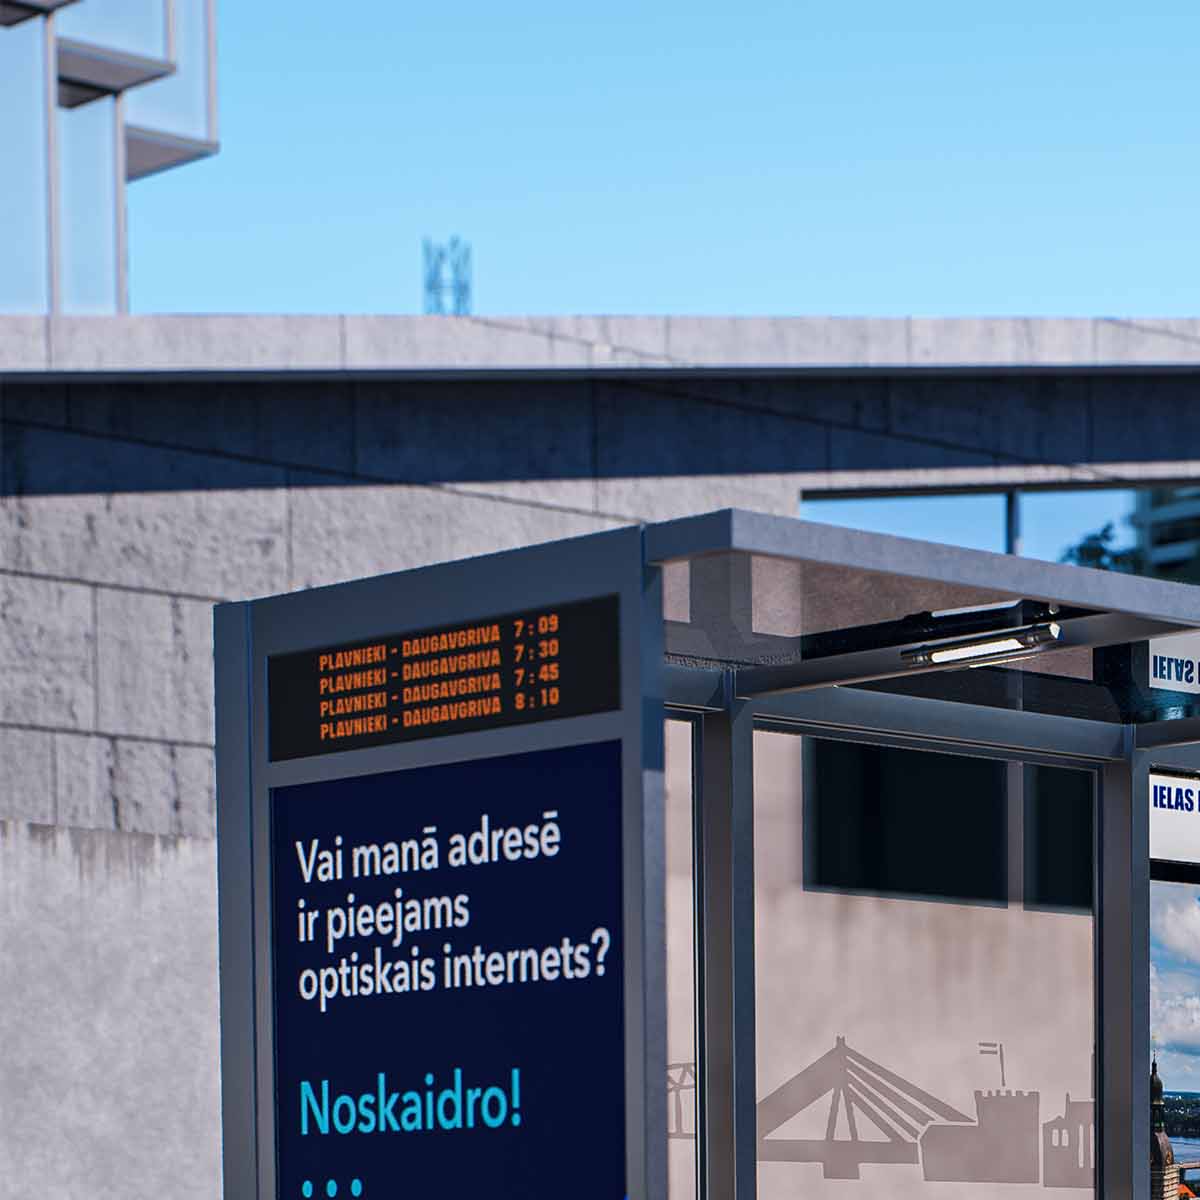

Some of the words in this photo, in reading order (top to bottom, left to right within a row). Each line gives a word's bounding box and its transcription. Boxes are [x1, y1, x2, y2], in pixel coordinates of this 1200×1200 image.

[1153, 784, 1195, 813] IELAS
[296, 835, 343, 883] Vai
[352, 826, 439, 878] manā
[448, 811, 560, 867] adresē
[298, 898, 319, 943] ir
[327, 887, 470, 953] pieejams
[299, 946, 436, 1013] optiskais
[443, 927, 611, 989] internets?
[300, 1067, 521, 1136] Noskaidro!
